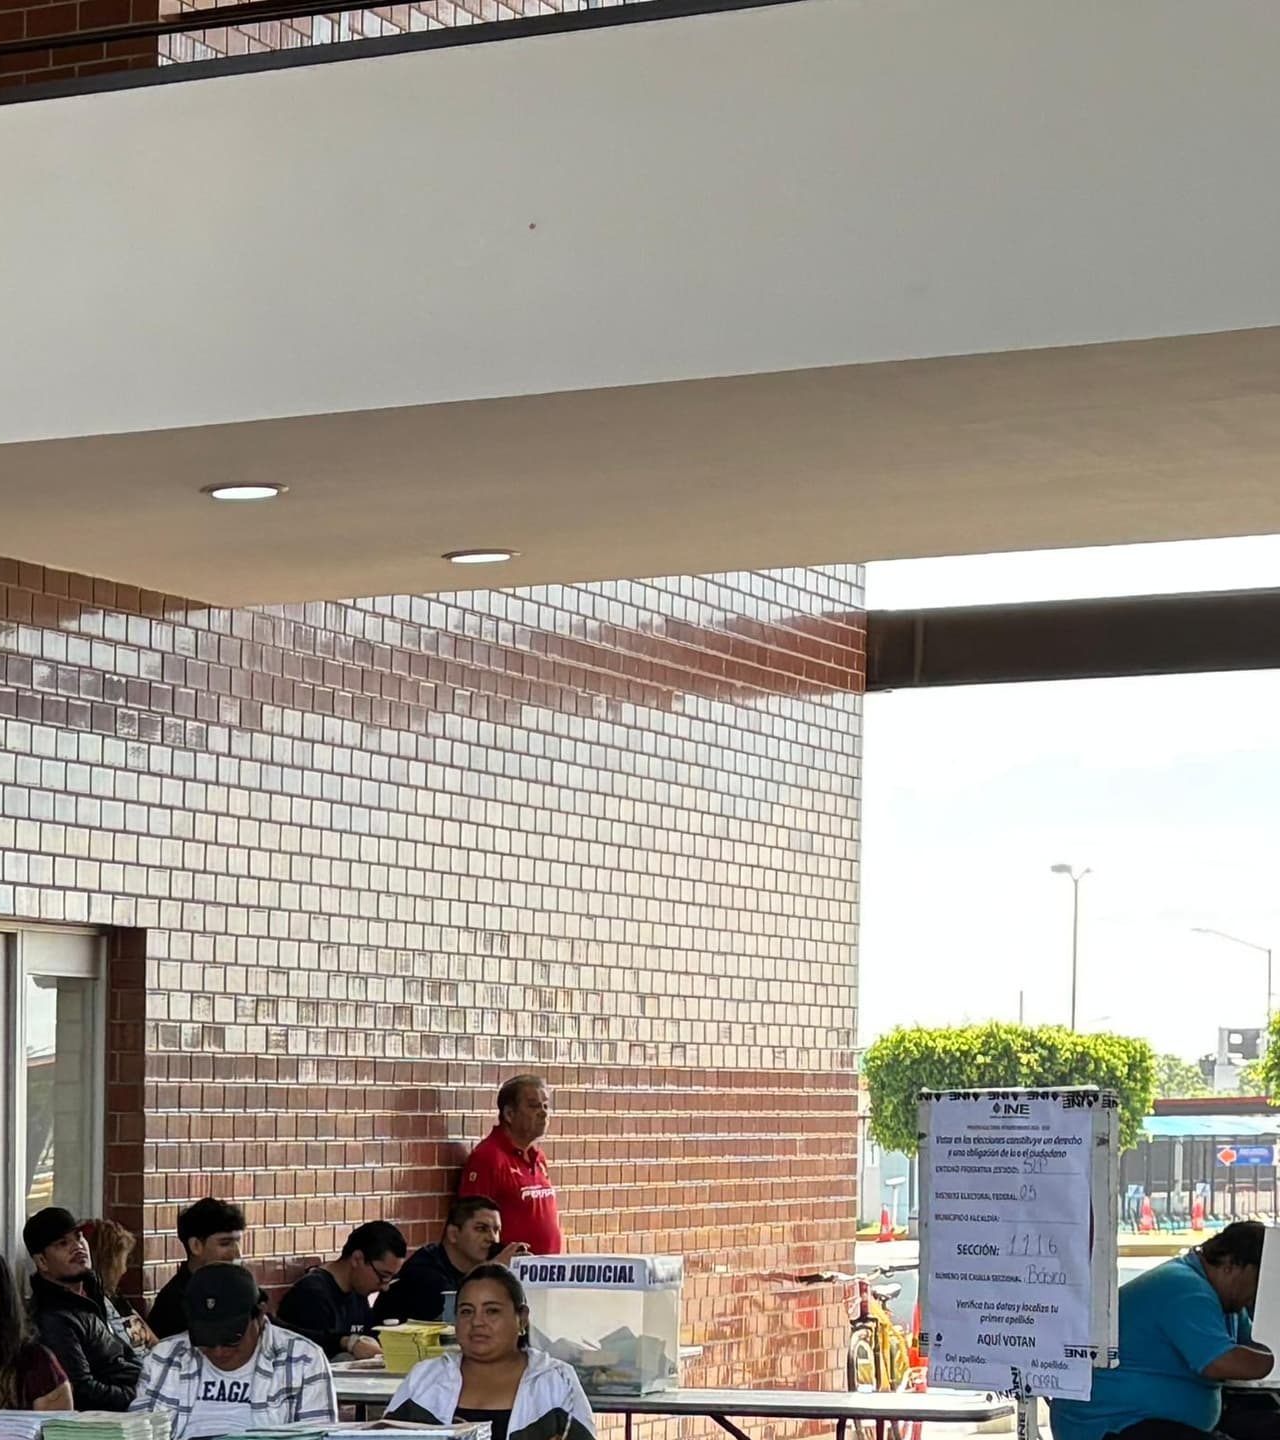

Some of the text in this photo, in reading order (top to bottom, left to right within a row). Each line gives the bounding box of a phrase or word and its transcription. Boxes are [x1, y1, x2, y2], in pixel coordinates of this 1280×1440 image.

[1003, 1104, 1030, 1114] INE
[957, 1243, 1000, 1256] SECCIÓN:
[520, 1264, 566, 1282] PODER
[569, 1264, 635, 1283] JUDICIAL
[977, 1333, 1036, 1347] AQUÍ VOTAN
